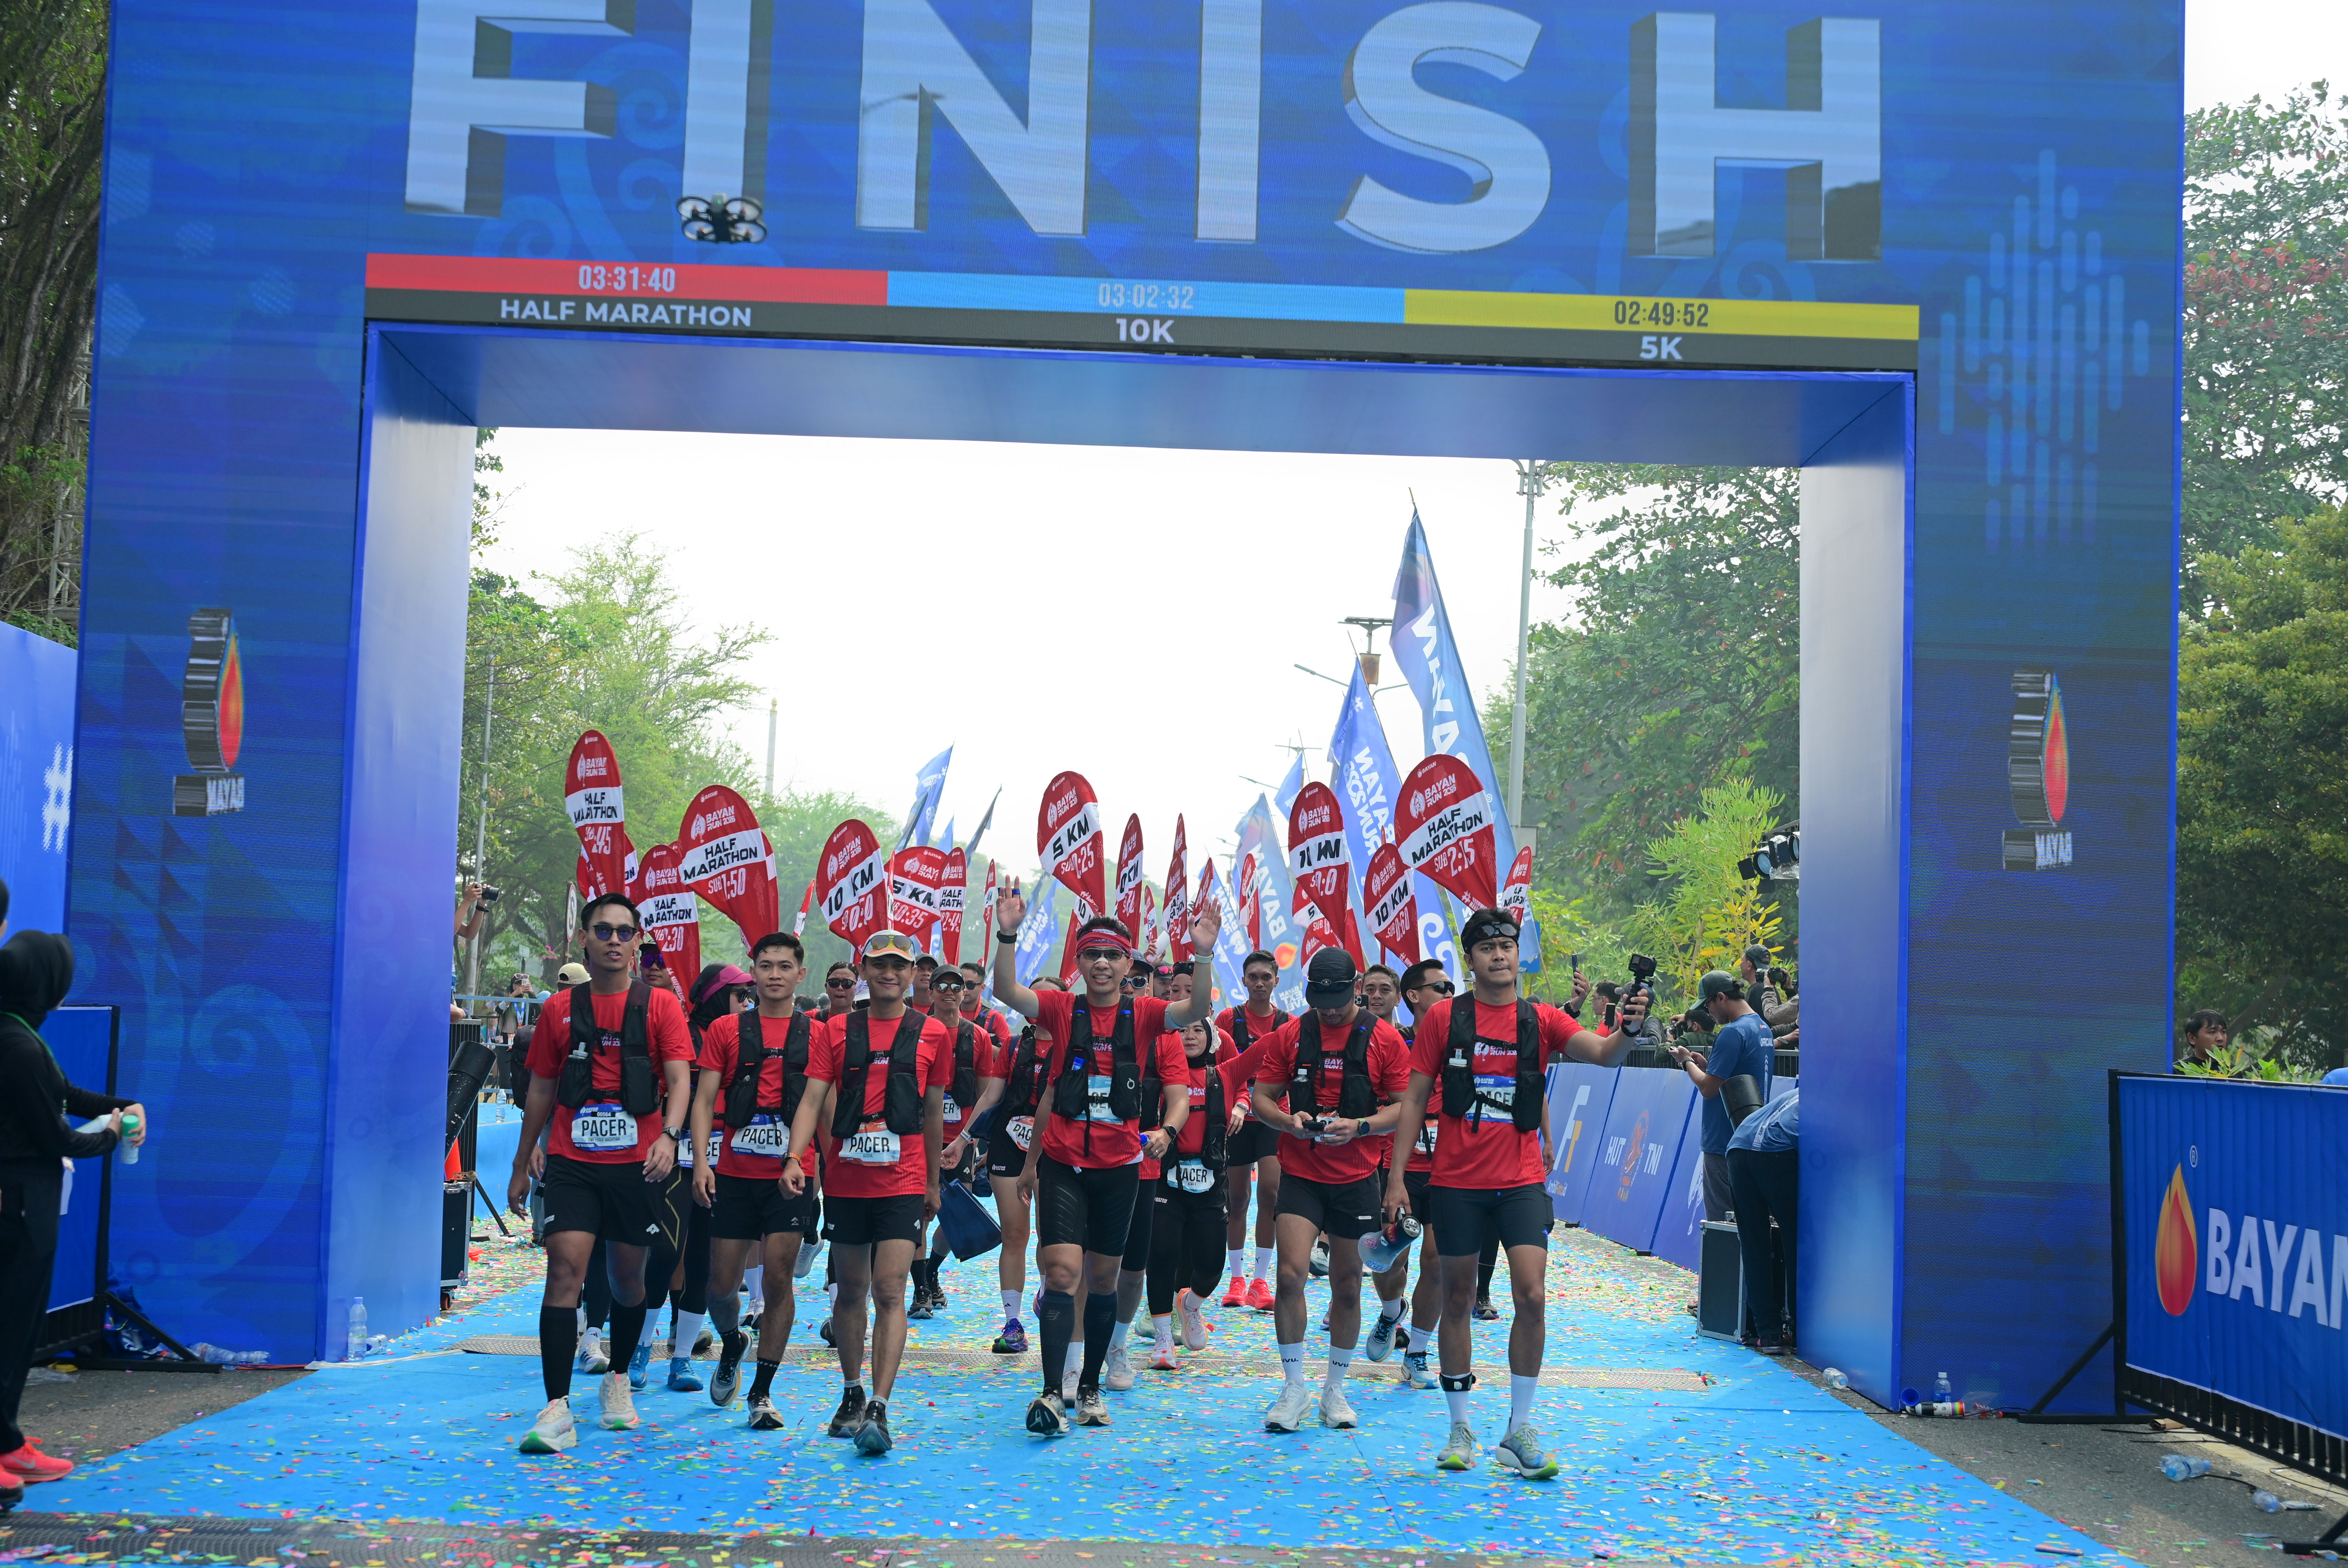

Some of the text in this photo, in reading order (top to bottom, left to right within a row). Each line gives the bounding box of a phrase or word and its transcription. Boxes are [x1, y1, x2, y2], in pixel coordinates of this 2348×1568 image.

[404, 0, 1882, 262] FINISH
[578, 264, 676, 292] 03:31:40
[1097, 283, 1195, 311] 03:02:32
[500, 298, 752, 327] HALF MARATHON
[1614, 299, 1710, 328] 02:49:52
[1114, 317, 1176, 345] 10K
[1640, 335, 1683, 360] 5K
[1424, 773, 1456, 797] BAYAN
[584, 792, 606, 806] HALF
[1057, 786, 1077, 810] BAYAN
[1426, 793, 1442, 807] RUN
[574, 806, 618, 824] MARATHON
[706, 805, 735, 823] BAYAN
[1058, 803, 1069, 818] RUN
[707, 820, 722, 831] RUN
[1308, 818, 1321, 828] RUN
[1428, 807, 1461, 837] HALF
[1053, 813, 1089, 861] 5 KM
[1411, 811, 1483, 865] MARATHON
[705, 837, 736, 860] HALF
[838, 835, 861, 863] BAYAN
[1317, 838, 1341, 862] KM
[1434, 837, 1475, 877] SUB 2:15
[683, 847, 758, 881] MARATHON
[838, 855, 850, 870] RUN
[919, 864, 940, 876] BAY
[1379, 857, 1396, 879] BAYAN
[655, 867, 678, 879] BAYAN
[917, 870, 934, 880] RUN
[1380, 873, 1390, 887] RUN
[708, 876, 722, 894] SUB
[828, 862, 874, 917] 10 KM
[893, 880, 905, 894] 5
[942, 889, 962, 898] HALF
[654, 898, 676, 912] HALF
[1375, 879, 1408, 927] 10 KM
[644, 908, 692, 928] MARATHON
[893, 904, 929, 929] 0:35
[1308, 905, 1315, 920] 5
[1313, 919, 1324, 931] SUB
[1386, 922, 1395, 939] SUB
[1760, 1037, 1773, 1047] OFFICIAL
[581, 1119, 626, 1137] PACER
[740, 1128, 782, 1146] PACER
[1013, 1123, 1032, 1141] PAC
[688, 1141, 722, 1157] PCE
[849, 1136, 890, 1153] PACER
[1604, 1136, 1664, 1175] HUT TNI
